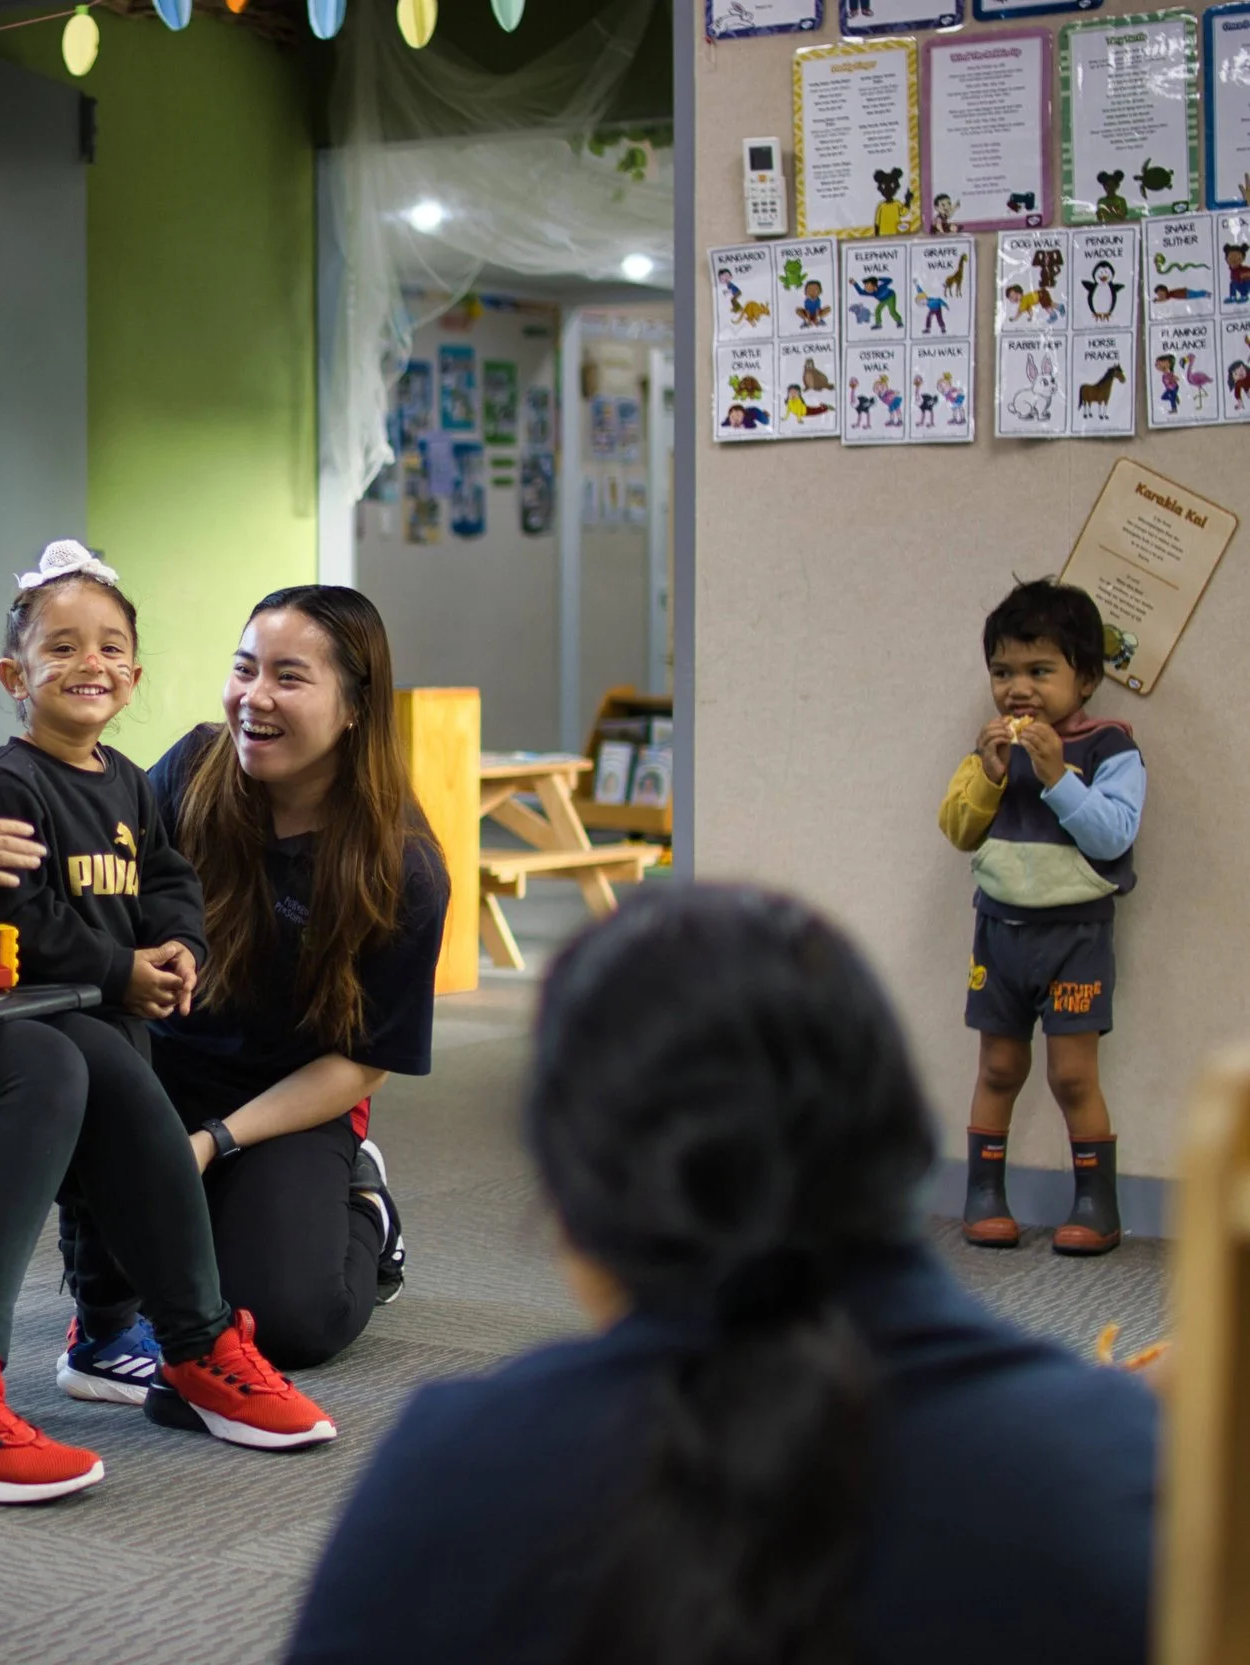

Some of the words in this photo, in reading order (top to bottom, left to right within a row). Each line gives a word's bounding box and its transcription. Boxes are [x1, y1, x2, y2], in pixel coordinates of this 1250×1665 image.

[1164, 223, 1196, 234] SNAKE
[1011, 240, 1032, 249] DOG
[1033, 239, 1061, 249] WALK
[1085, 236, 1124, 246] PENGUIN
[1163, 235, 1199, 247] SLITHER
[780, 247, 802, 258] FROG
[803, 246, 828, 257] JUMP
[855, 250, 899, 262] ELEPHANT
[923, 248, 958, 258] GIRAFFE
[1084, 248, 1124, 259] WADDLE
[717, 252, 766, 264] KANGAROO
[734, 264, 752, 274] HOP
[862, 263, 890, 273] WALK
[927, 261, 954, 270] WALK
[1161, 326, 1207, 338] FLAMINGO
[1008, 340, 1041, 350] RABBIT
[1088, 339, 1116, 348] HORSE
[1162, 339, 1206, 351] BALANCE
[731, 349, 762, 359] TURTLE
[782, 347, 800, 356] SEAL
[802, 344, 833, 355] CRAWL
[918, 349, 937, 358] EMU
[938, 347, 963, 357] WALK
[1084, 350, 1120, 361] PRANCE
[859, 351, 895, 361] OSTRICH
[731, 361, 761, 371] CRAWL
[863, 362, 890, 372] WALK
[1135, 481, 1184, 517] Karakia
[1054, 998, 1091, 1014] KING
